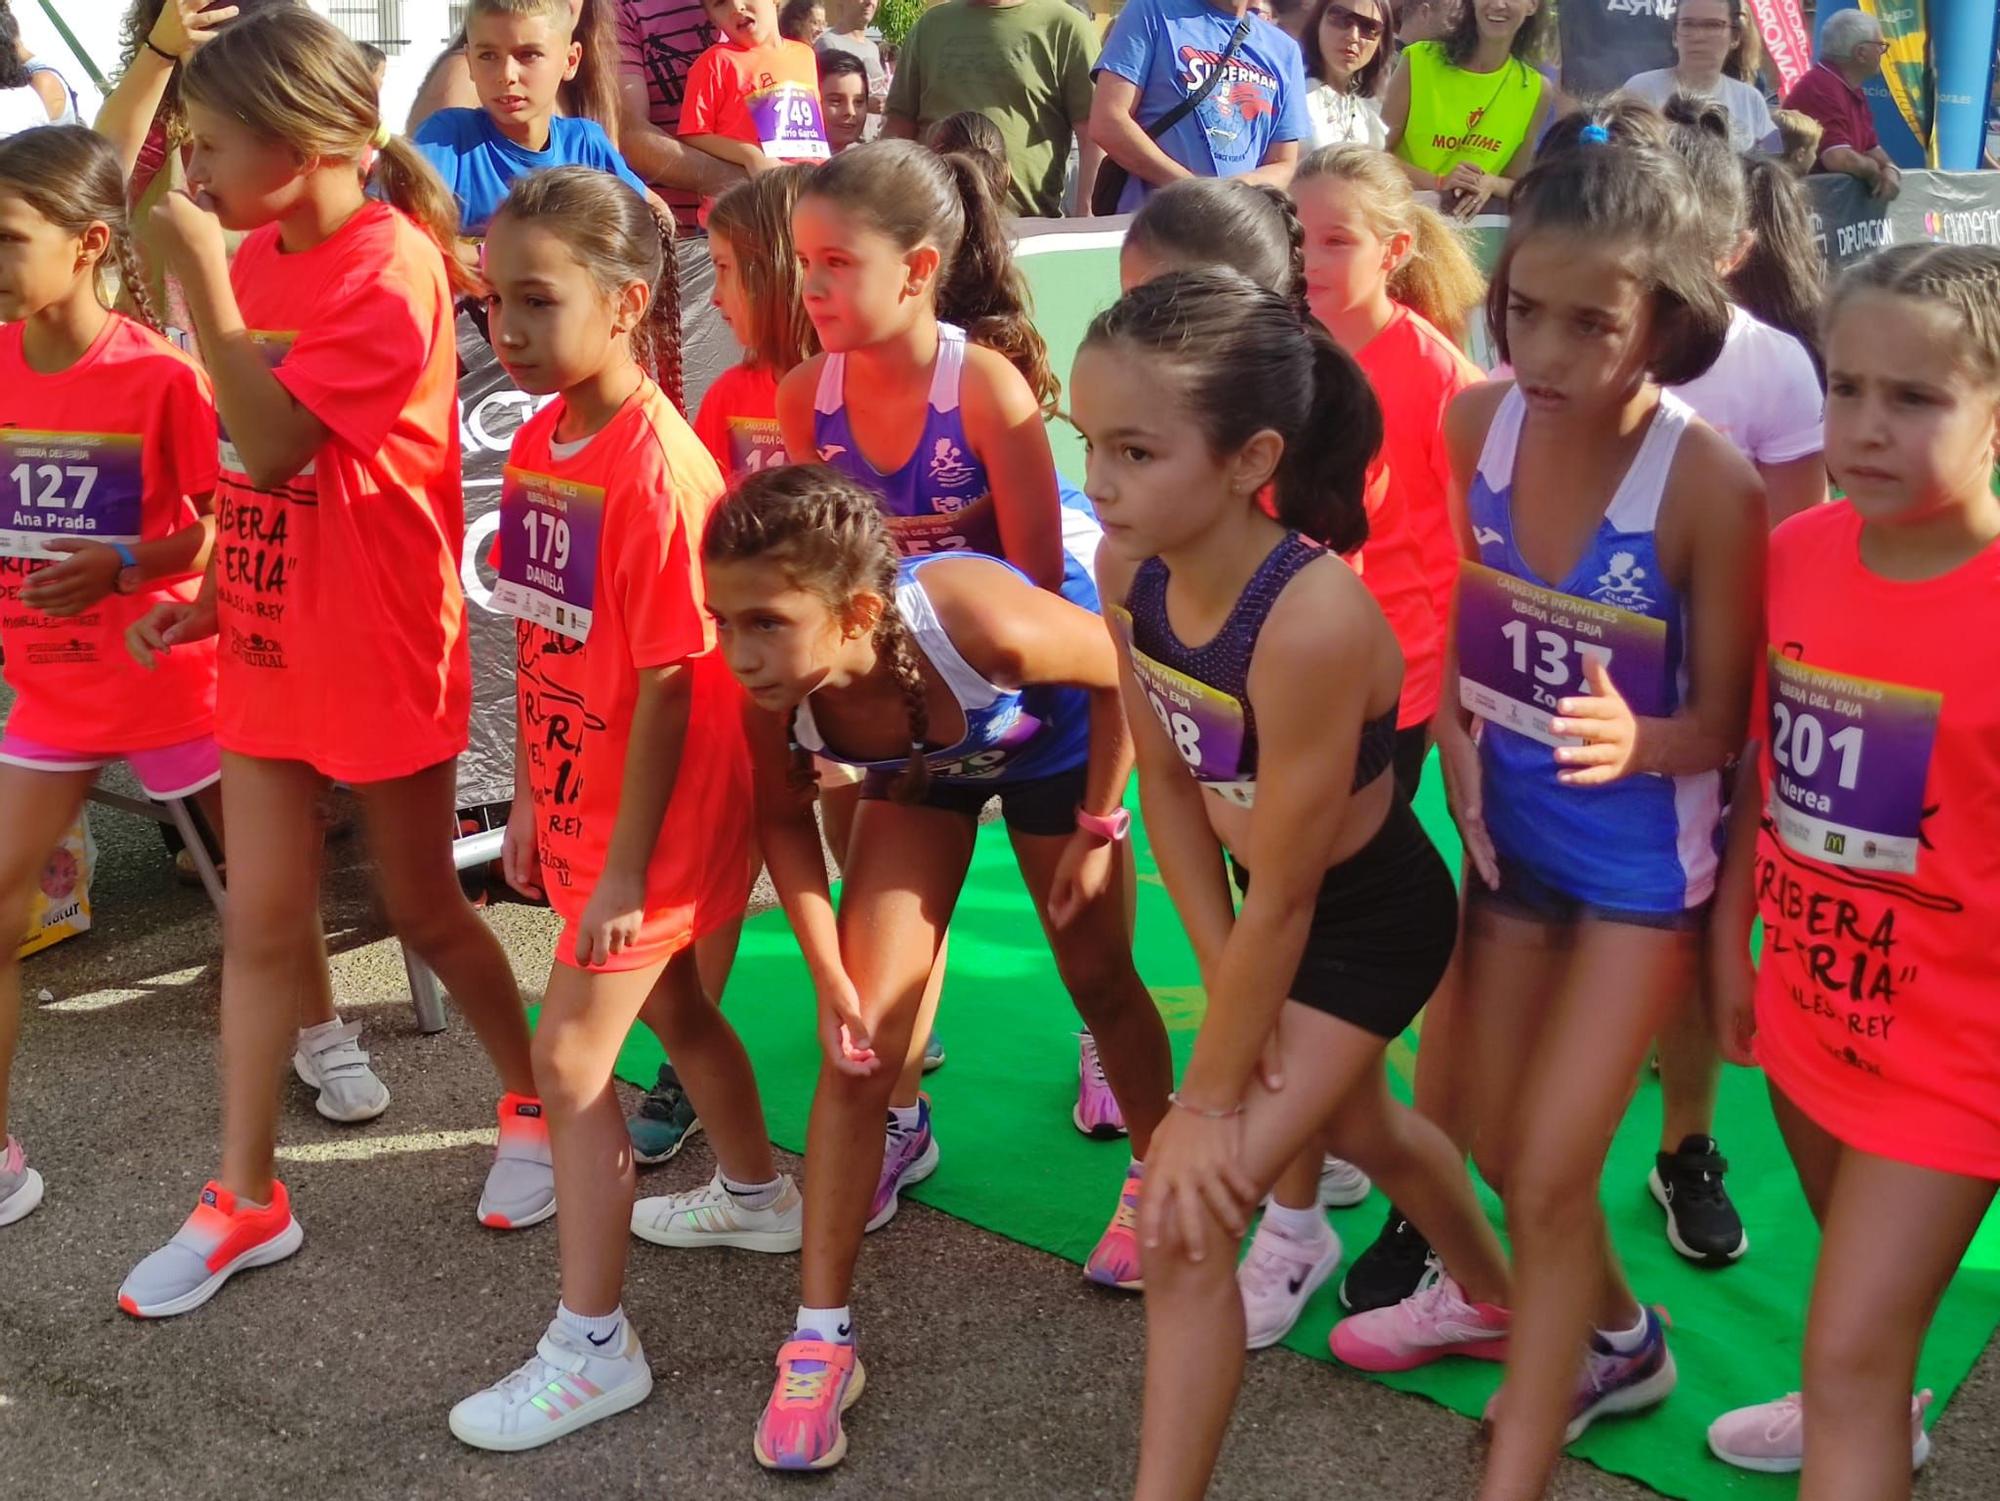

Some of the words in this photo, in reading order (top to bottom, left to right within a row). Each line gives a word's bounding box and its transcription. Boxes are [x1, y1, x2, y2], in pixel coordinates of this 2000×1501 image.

[773, 99, 813, 128] 149
[9, 463, 99, 510] 127
[13, 510, 43, 527] Ana
[46, 513, 97, 530] Prada
[522, 509, 570, 570] 179
[525, 563, 565, 595] DANIELA
[255, 600, 286, 624] REY
[1497, 577, 1548, 604] CARRERAS
[1551, 597, 1619, 625] INFANTILES
[1511, 598, 1548, 624] RIBERA
[1575, 623, 1602, 639] ERIA
[1501, 618, 1613, 695] 137
[1808, 691, 1831, 709] DEL
[1833, 699, 1863, 719] ERIA
[1773, 702, 1864, 790] 201
[1780, 773, 1831, 813] Nerea
[1848, 1013, 1896, 1040] REY
